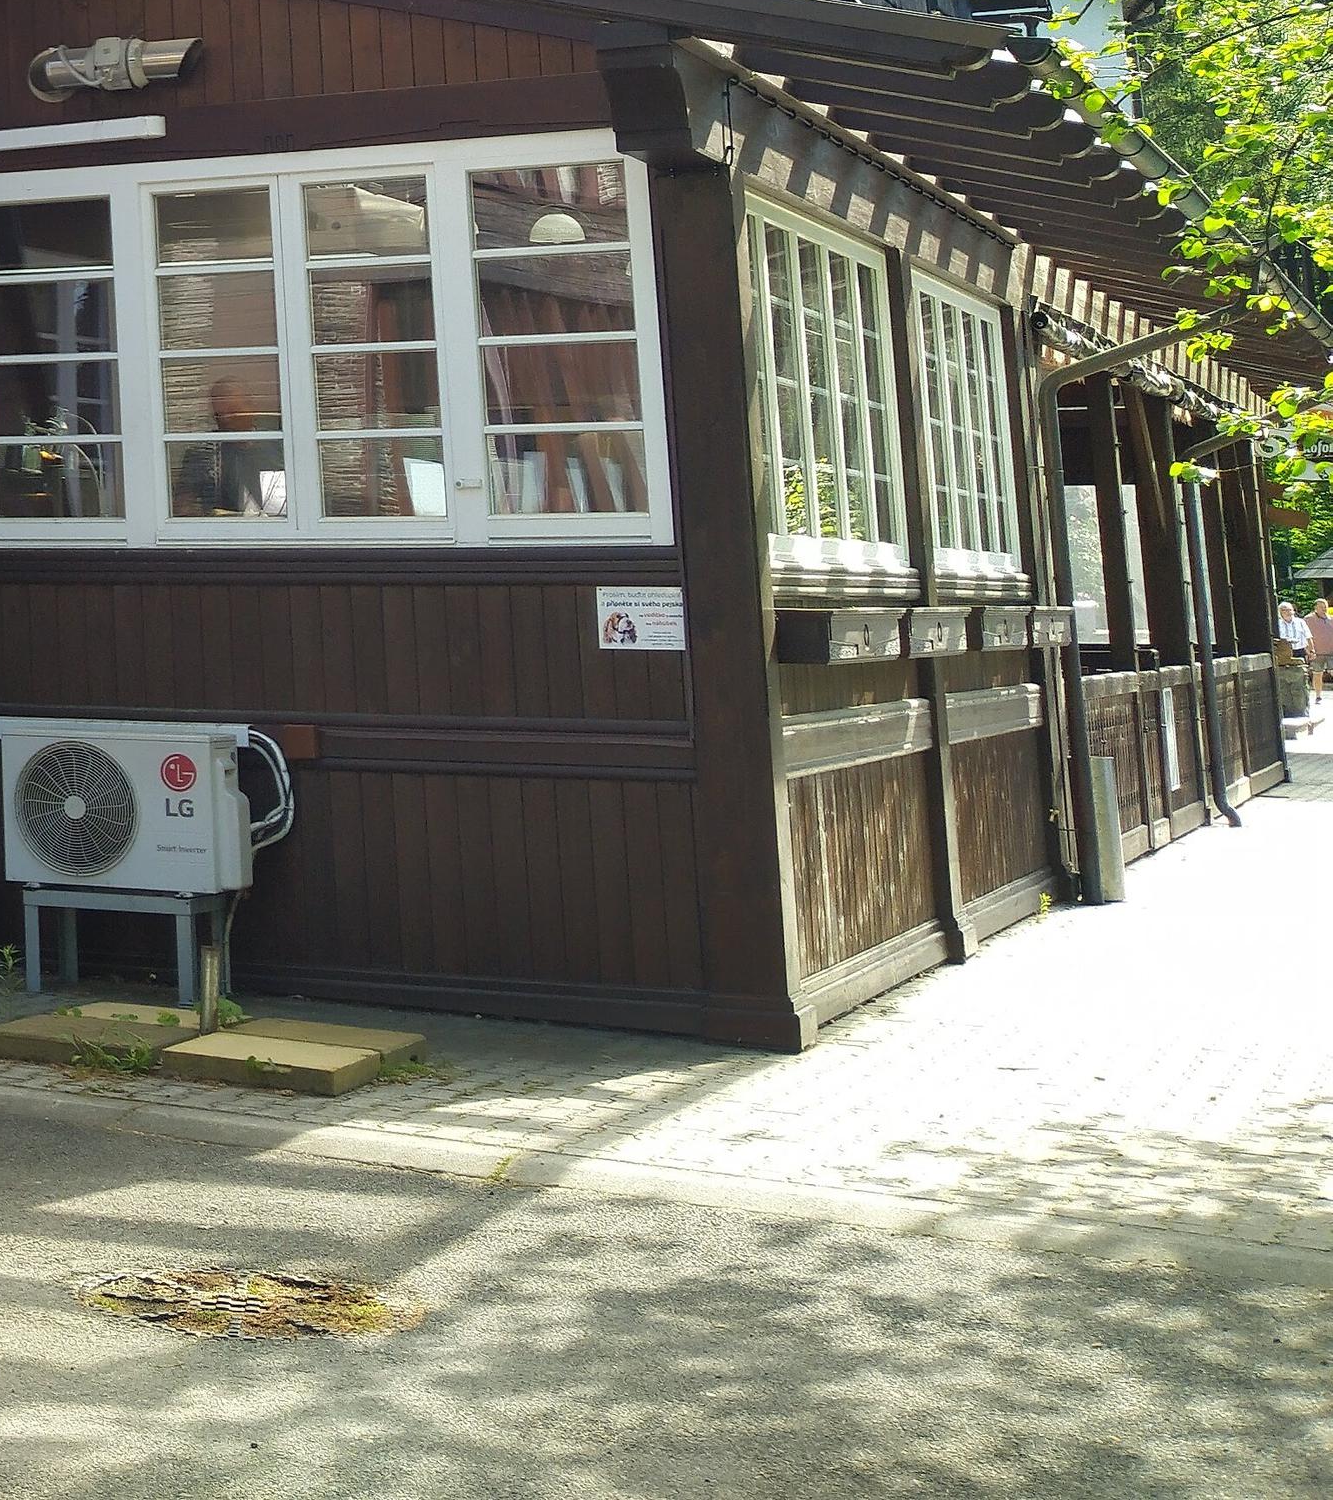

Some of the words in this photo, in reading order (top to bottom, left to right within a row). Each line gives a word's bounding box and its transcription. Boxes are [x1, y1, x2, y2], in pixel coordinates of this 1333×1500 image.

[165, 798, 194, 818] LG
[156, 844, 177, 852] Smart
[178, 844, 206, 854] Inverter
